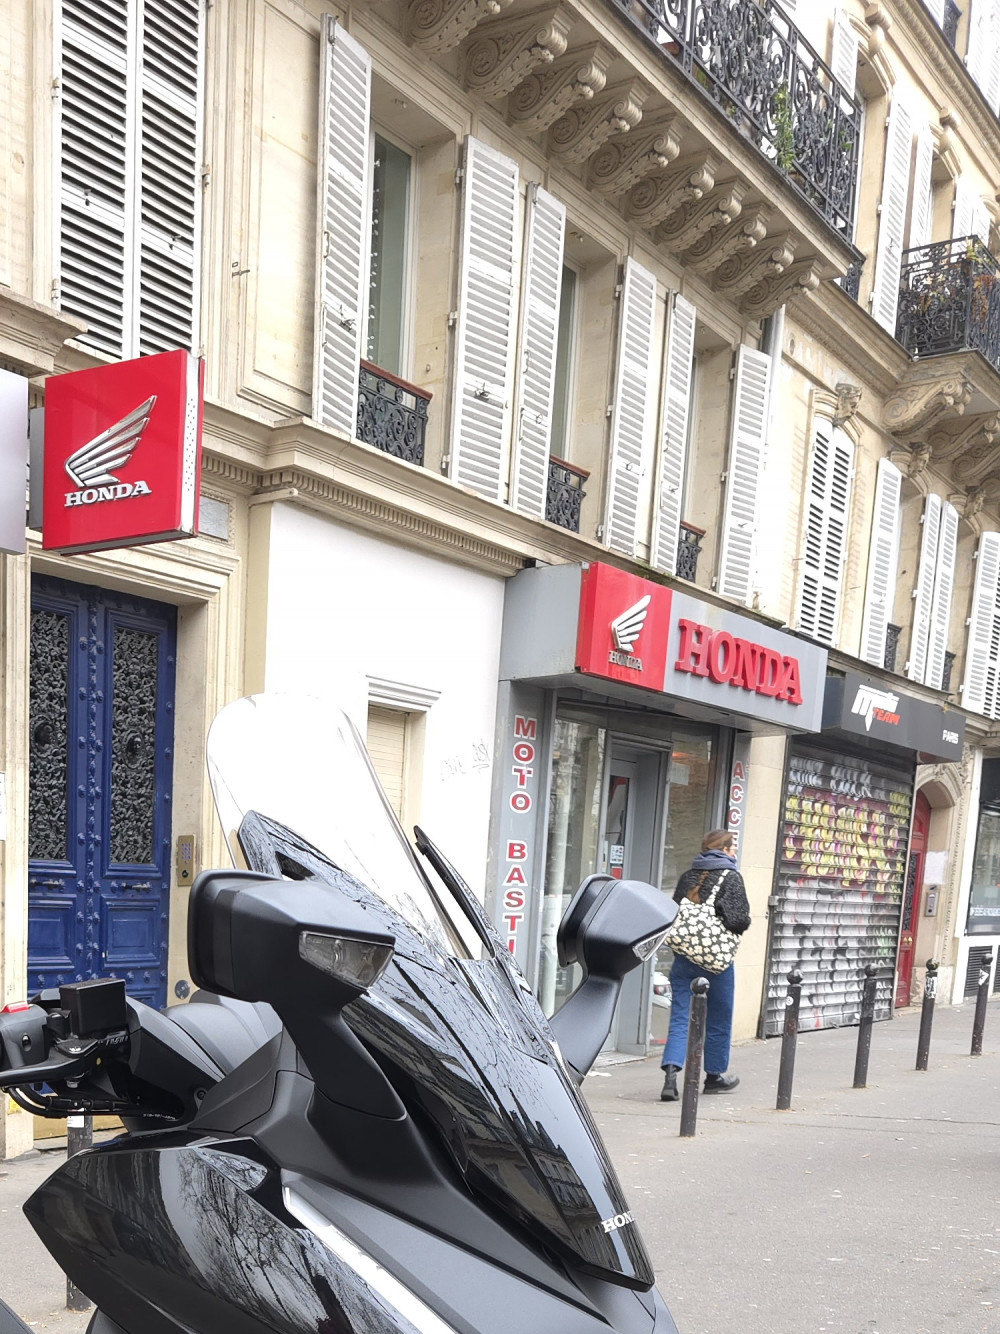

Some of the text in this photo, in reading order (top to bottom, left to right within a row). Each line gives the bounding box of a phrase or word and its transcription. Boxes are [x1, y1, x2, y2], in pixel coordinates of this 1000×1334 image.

[63, 480, 153, 507] HONDA
[608, 650, 643, 671] HONDA
[675, 618, 803, 705] HONDA
[872, 707, 900, 726] TEAM
[509, 715, 537, 814] MOTO
